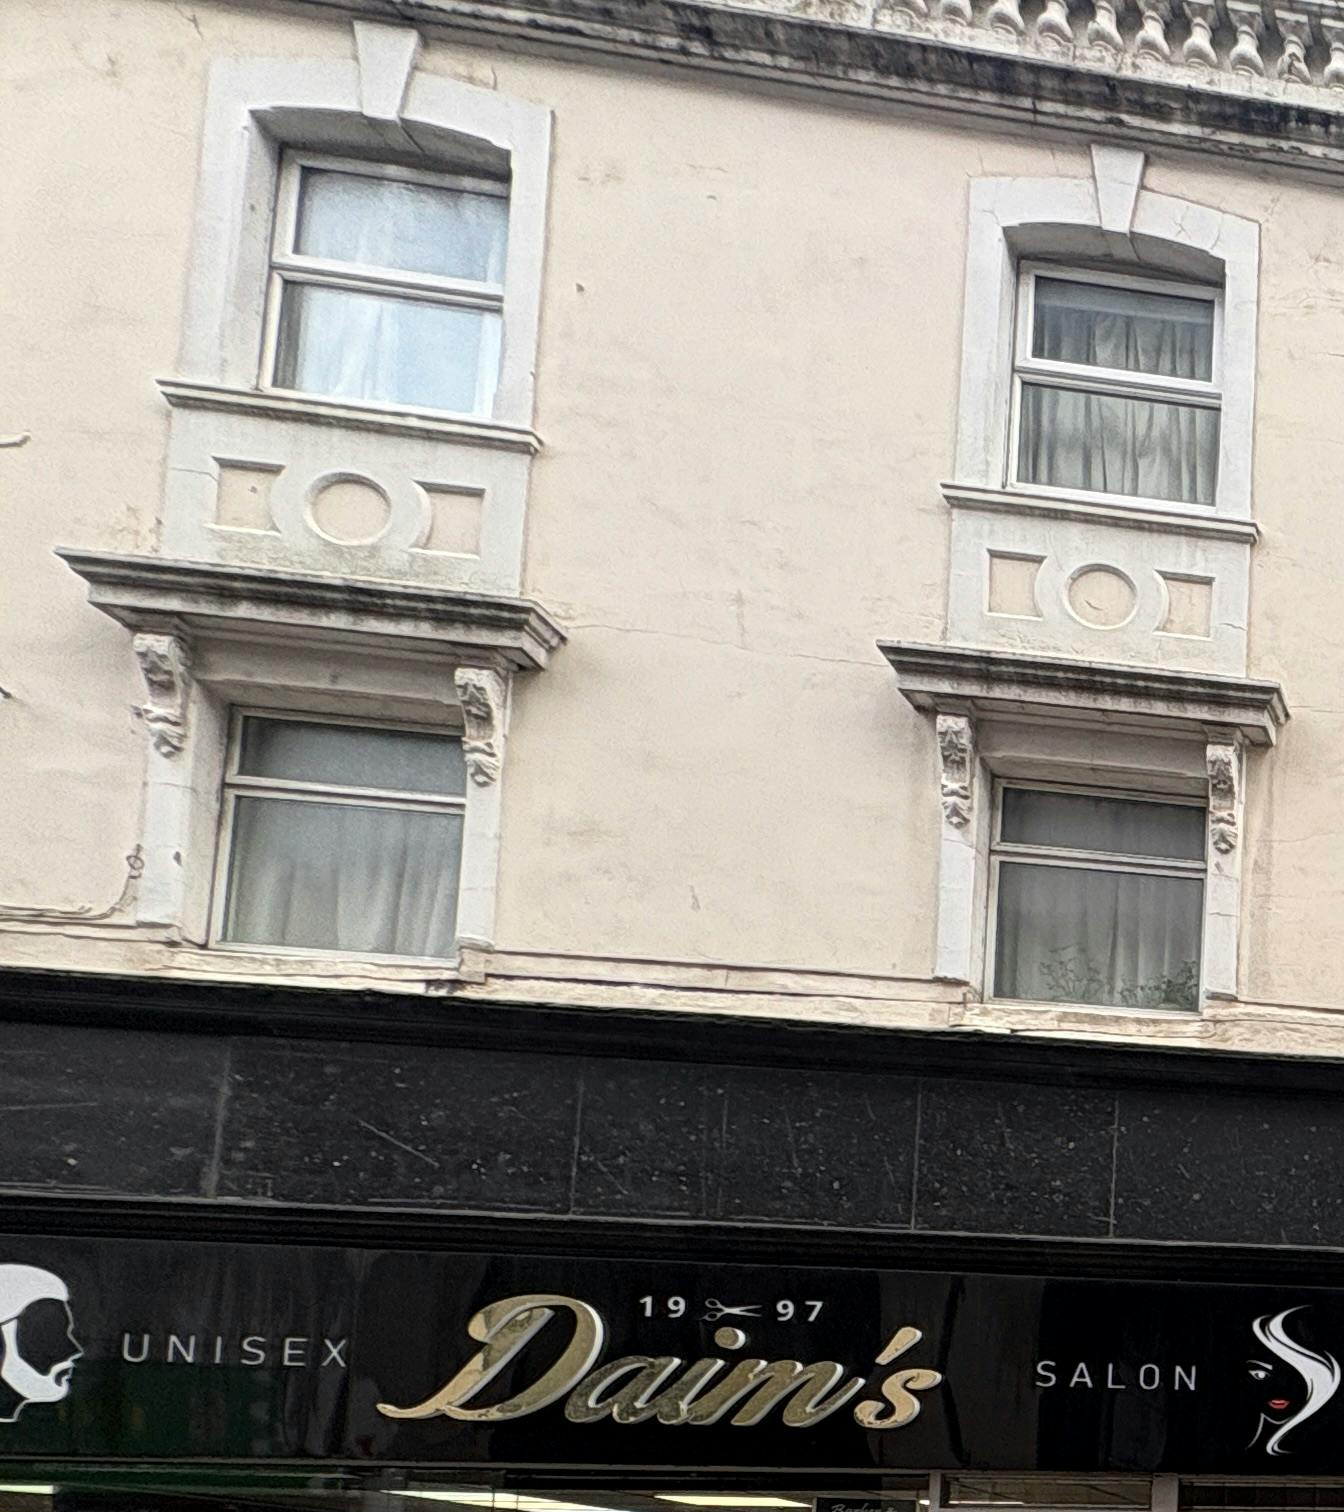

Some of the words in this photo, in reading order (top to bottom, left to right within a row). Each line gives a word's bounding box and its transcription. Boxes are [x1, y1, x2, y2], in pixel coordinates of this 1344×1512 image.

[122, 1333, 349, 1368] UNISEX
[376, 1294, 946, 1430] Daim's
[1036, 1359, 1200, 1392] SALON
